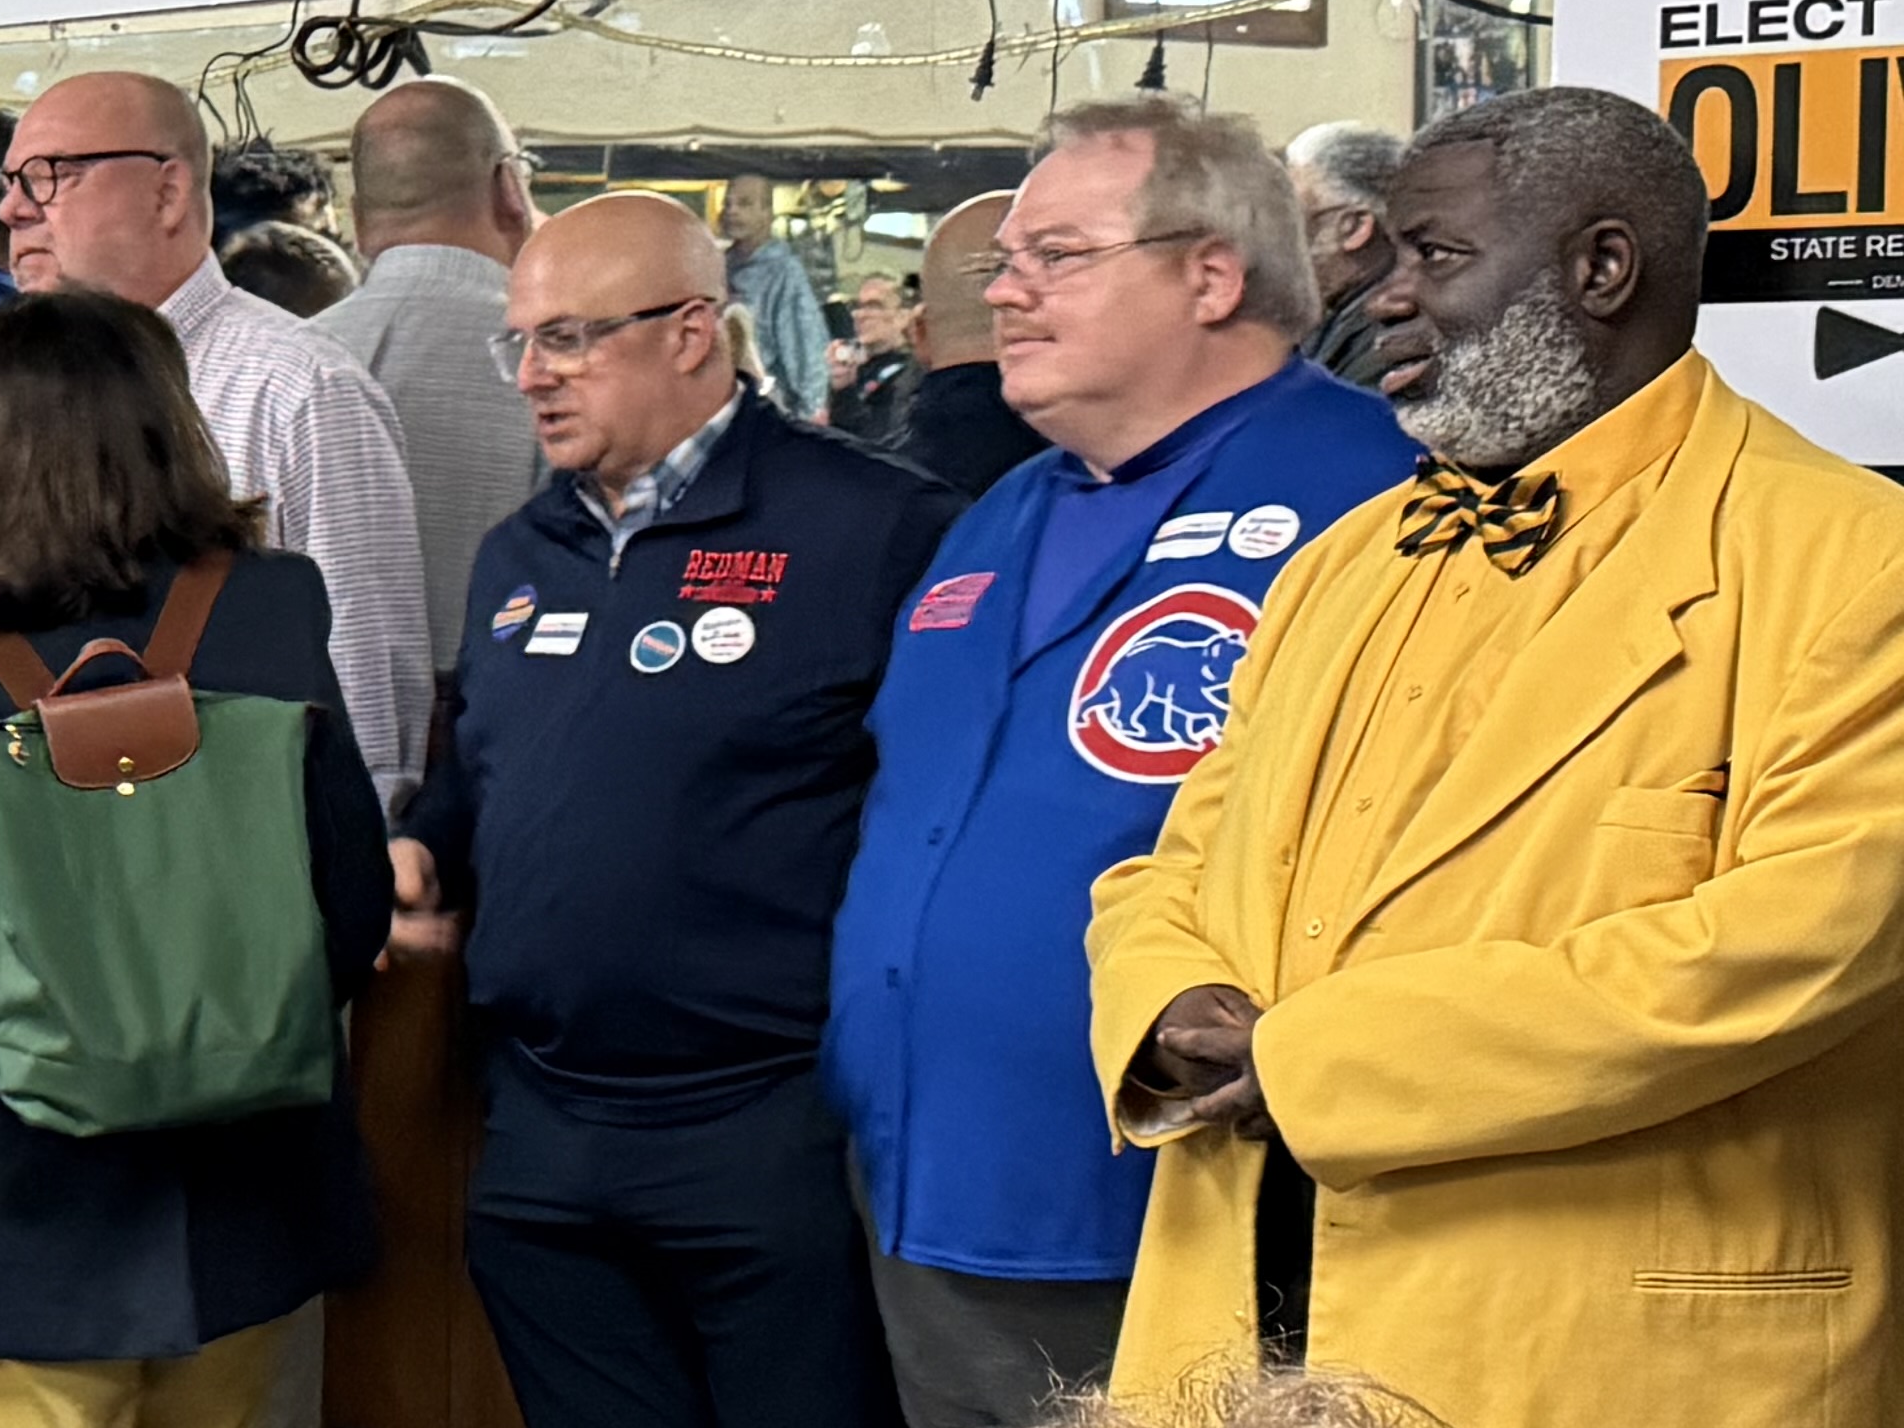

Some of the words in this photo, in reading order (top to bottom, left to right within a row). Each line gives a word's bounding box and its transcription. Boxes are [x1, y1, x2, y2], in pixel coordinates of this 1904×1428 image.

[1667, 56, 1904, 223] OLI
[1770, 236, 1857, 261] STATE
[682, 549, 789, 583] REDMAN
